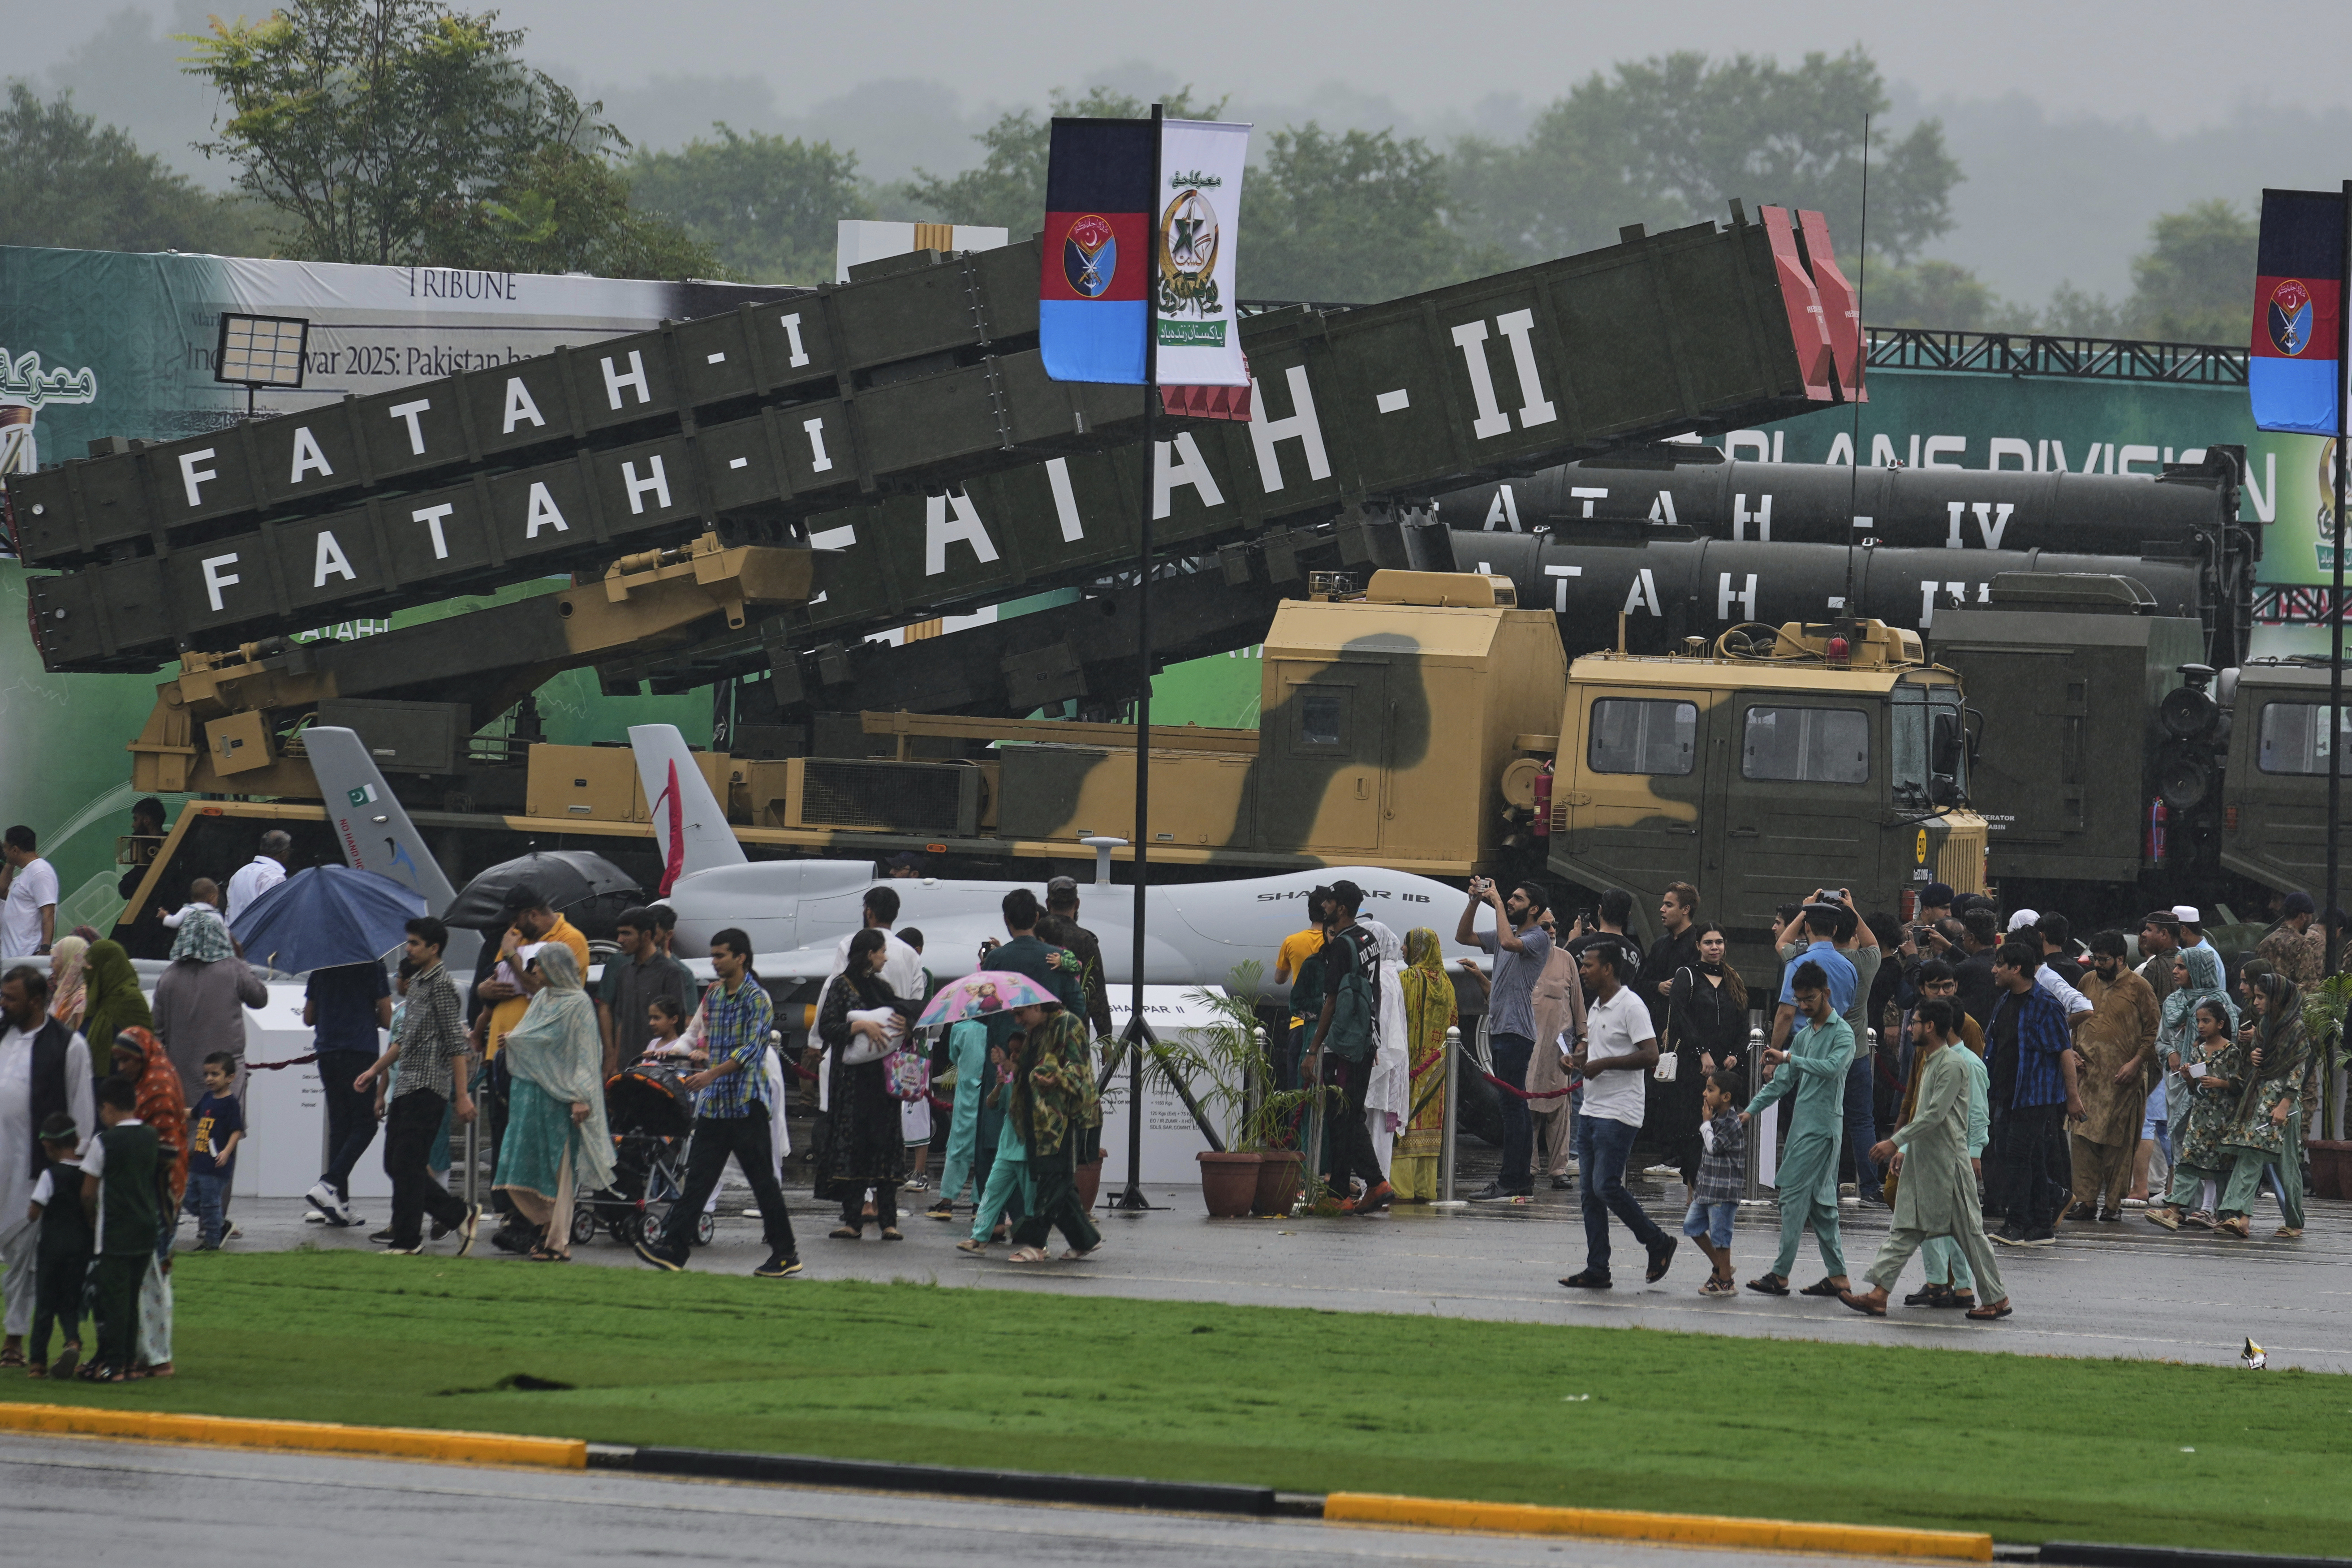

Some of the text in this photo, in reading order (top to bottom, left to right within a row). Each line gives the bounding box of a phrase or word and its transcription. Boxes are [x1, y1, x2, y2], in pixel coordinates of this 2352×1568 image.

[405, 267, 517, 300] TRIBUNE
[345, 346, 400, 375] 2025:
[339, 819, 365, 870] NO HAND HO
[1257, 889, 1430, 903] SHAAR IIB
[1109, 1005, 1171, 1014] SHAPAR
